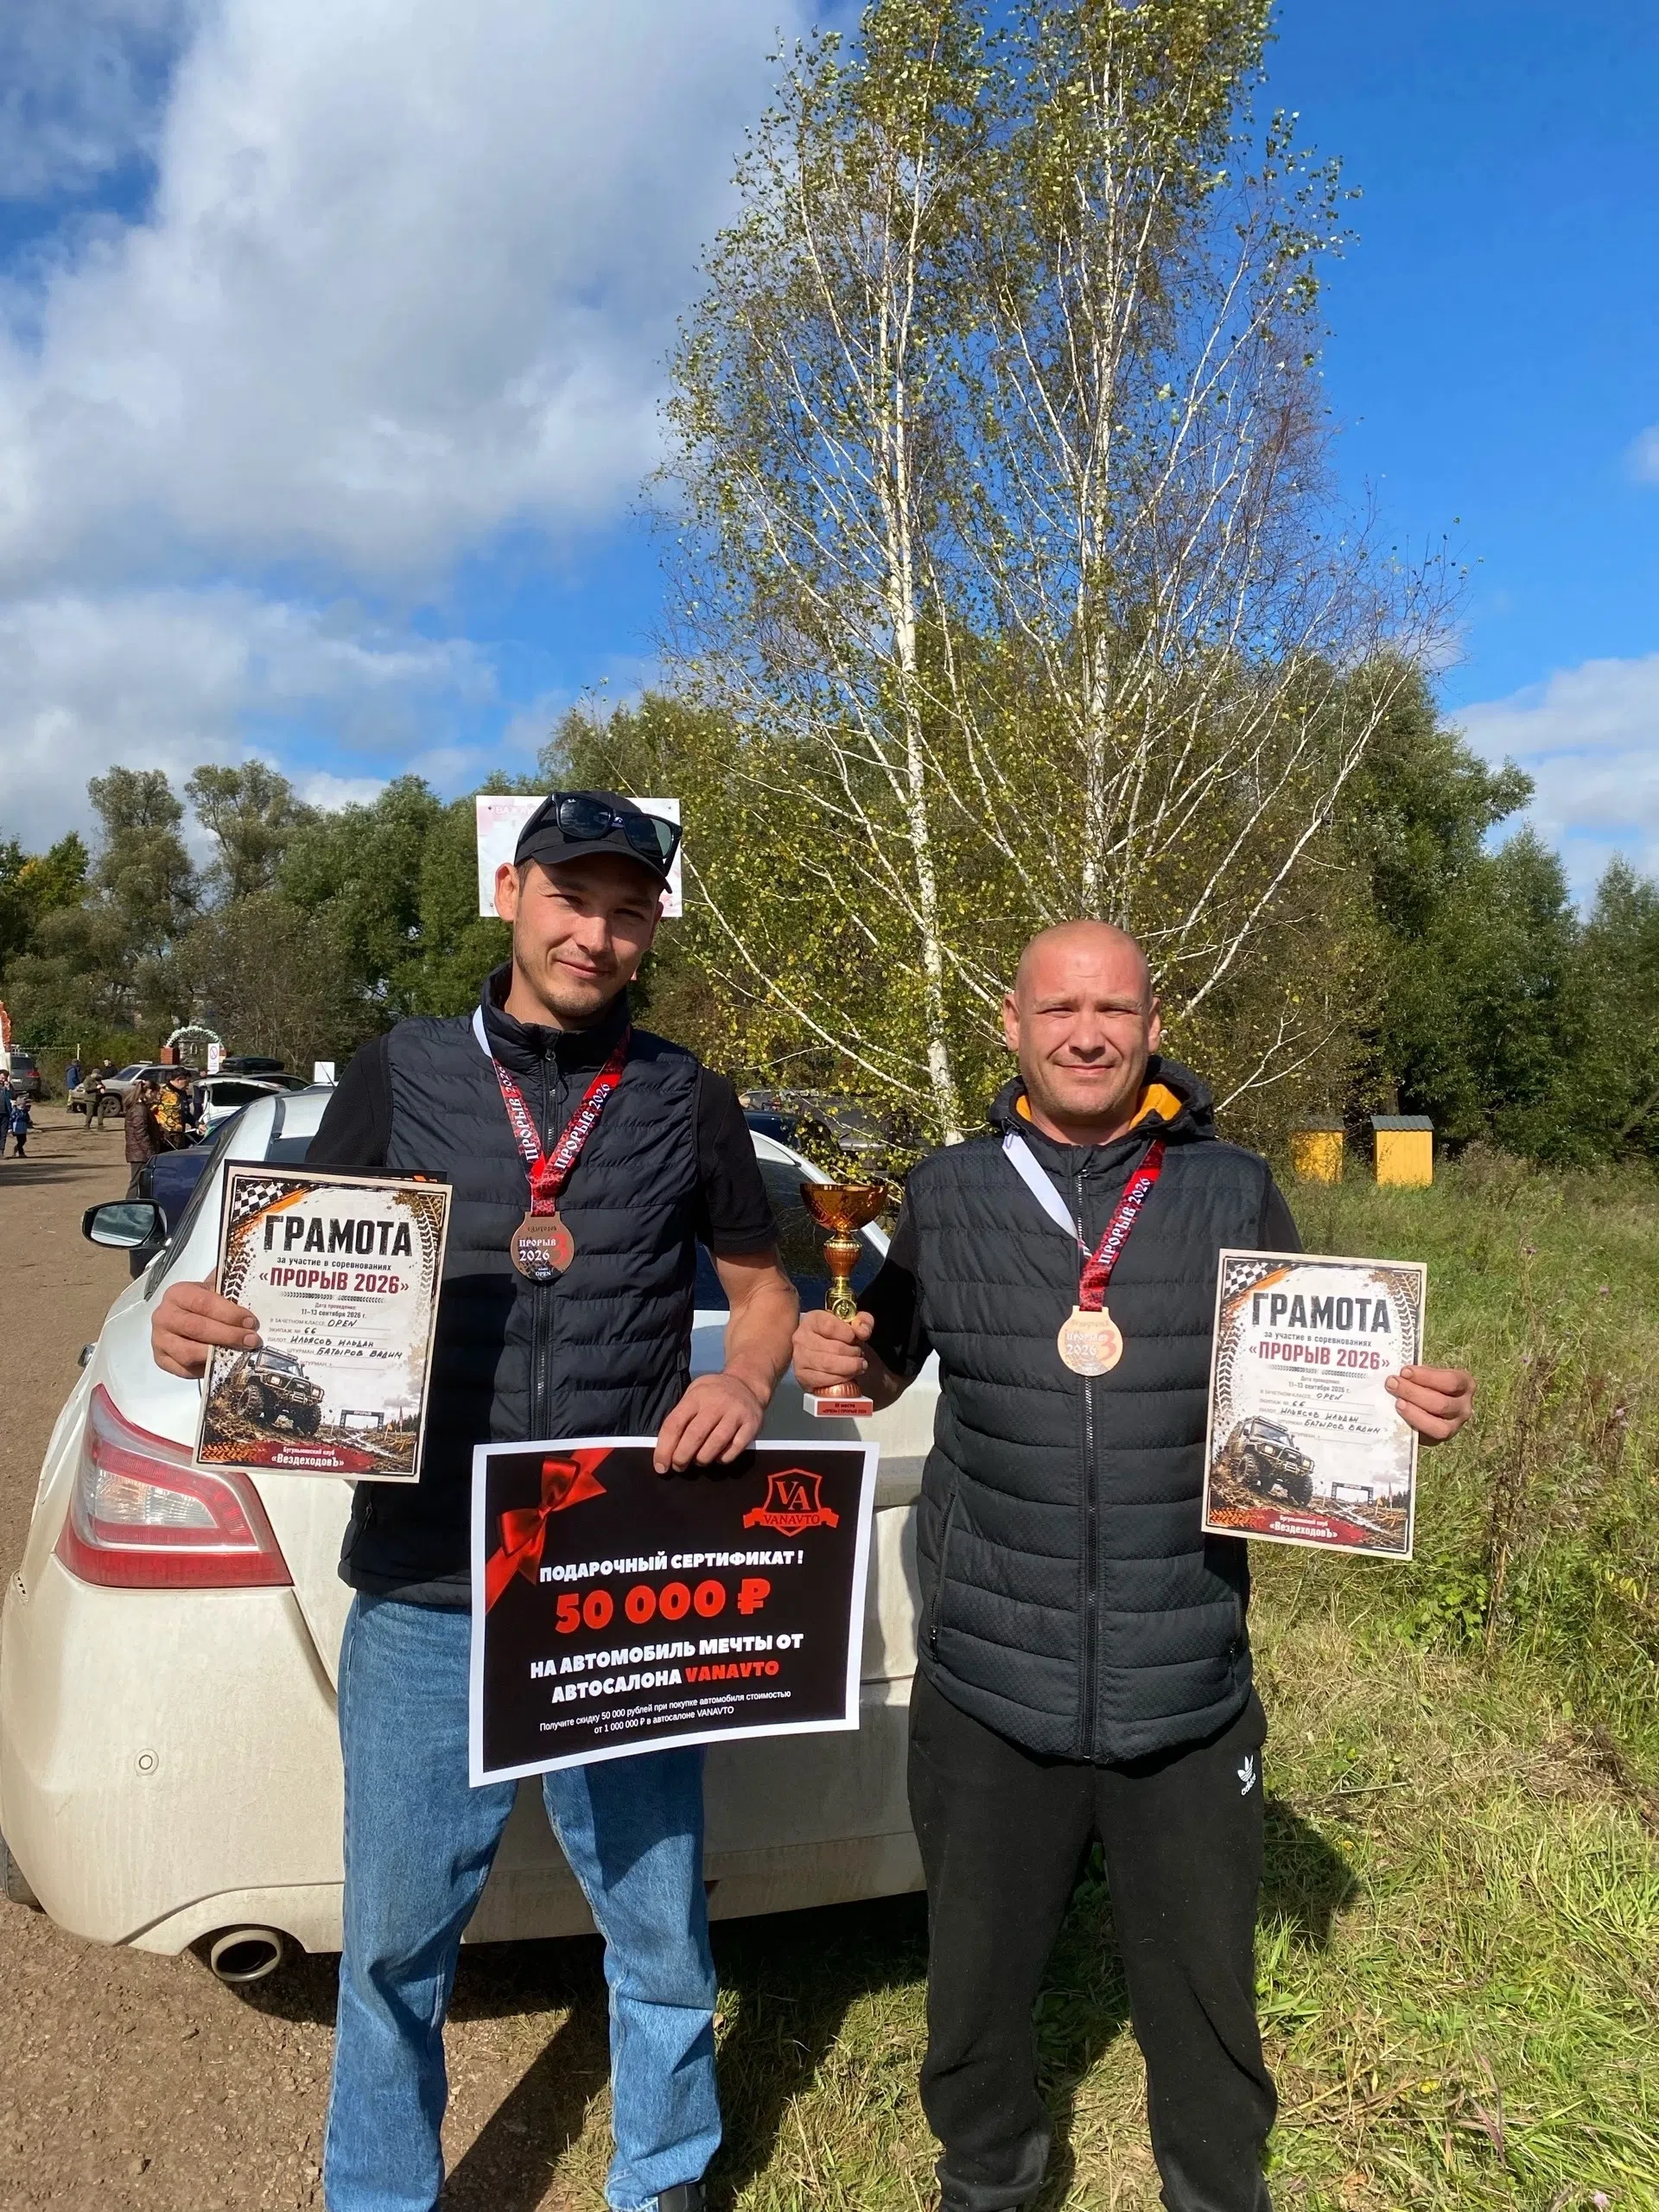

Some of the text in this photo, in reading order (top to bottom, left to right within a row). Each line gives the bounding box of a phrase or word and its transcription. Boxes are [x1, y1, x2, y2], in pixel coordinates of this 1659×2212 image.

[508, 1097, 539, 1160] ПРОРЫВ
[554, 1082, 610, 1169] ПРОРЫВ 2026
[1097, 1177, 1150, 1264] ПРОРЫВ 2026
[263, 1215, 413, 1256] ГРАМОТА
[518, 1238, 556, 1247] ПРОРЫВ
[289, 1257, 321, 1267] участие
[332, 1262, 391, 1271] соревнованиях
[519, 1249, 550, 1262] 2026
[259, 1267, 410, 1294] «ПРОРЫВ 2026»
[1252, 1293, 1392, 1333] ГРАМОТА
[289, 1335, 333, 1345] ИЛЬЯСОВ
[316, 1347, 403, 1359] БАТЫРОВ ВАДИМ
[1066, 1344, 1096, 1356] 2026
[1314, 1336, 1372, 1347] соревнованиях
[1249, 1341, 1390, 1370] «ПРОРЫВ 2026»
[1304, 1419, 1344, 1430] БАТЫРОВ
[775, 1481, 810, 1510] VA
[764, 1515, 820, 1524] VANAVTO
[539, 1550, 804, 1582] ПОДАРОЧНЫЙ СЕРТИФИКАТ !
[555, 1578, 771, 1633] 50 000 ₽
[530, 1634, 804, 1679] НА АВТОМОБИЛЬ МЕЧТЫ ОТ
[551, 1661, 779, 1703] АВТОСАЛОНА VANAVTO
[539, 1690, 791, 1732] Получите скидку 50 000 рублей при покупке автомобиля стоимостью
[610, 1721, 624, 1731] 000
[625, 1719, 639, 1728] 000
[652, 1711, 696, 1724] автосалоне
[696, 1706, 734, 1718] VANAVTO
